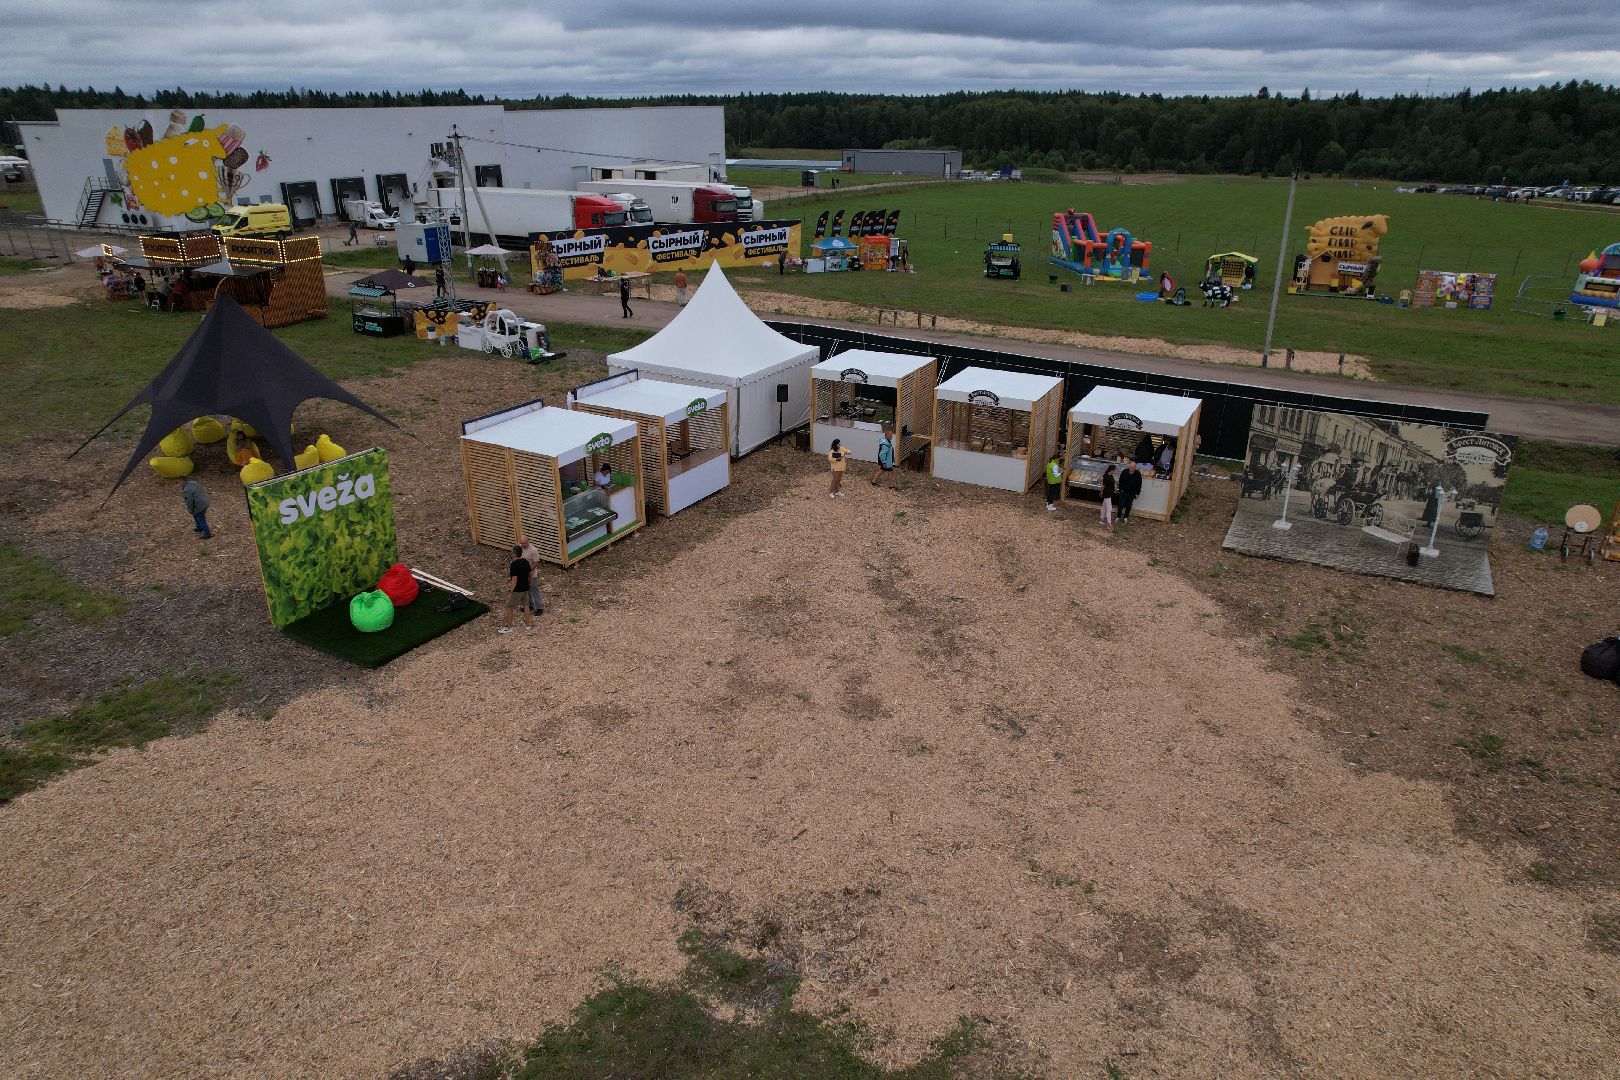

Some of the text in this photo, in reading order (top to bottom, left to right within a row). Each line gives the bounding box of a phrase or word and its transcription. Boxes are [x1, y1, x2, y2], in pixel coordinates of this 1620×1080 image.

[1330, 226, 1357, 236] СЫР
[652, 232, 700, 249] СЫРНЫЙ
[744, 229, 787, 245] СЫРНЫЙ
[1328, 238, 1357, 248] ПИР
[656, 249, 697, 260] ФЕСТИВАЛЬ
[748, 245, 785, 256] ФЕСТИВАЛЬ
[279, 473, 375, 525] sveža
